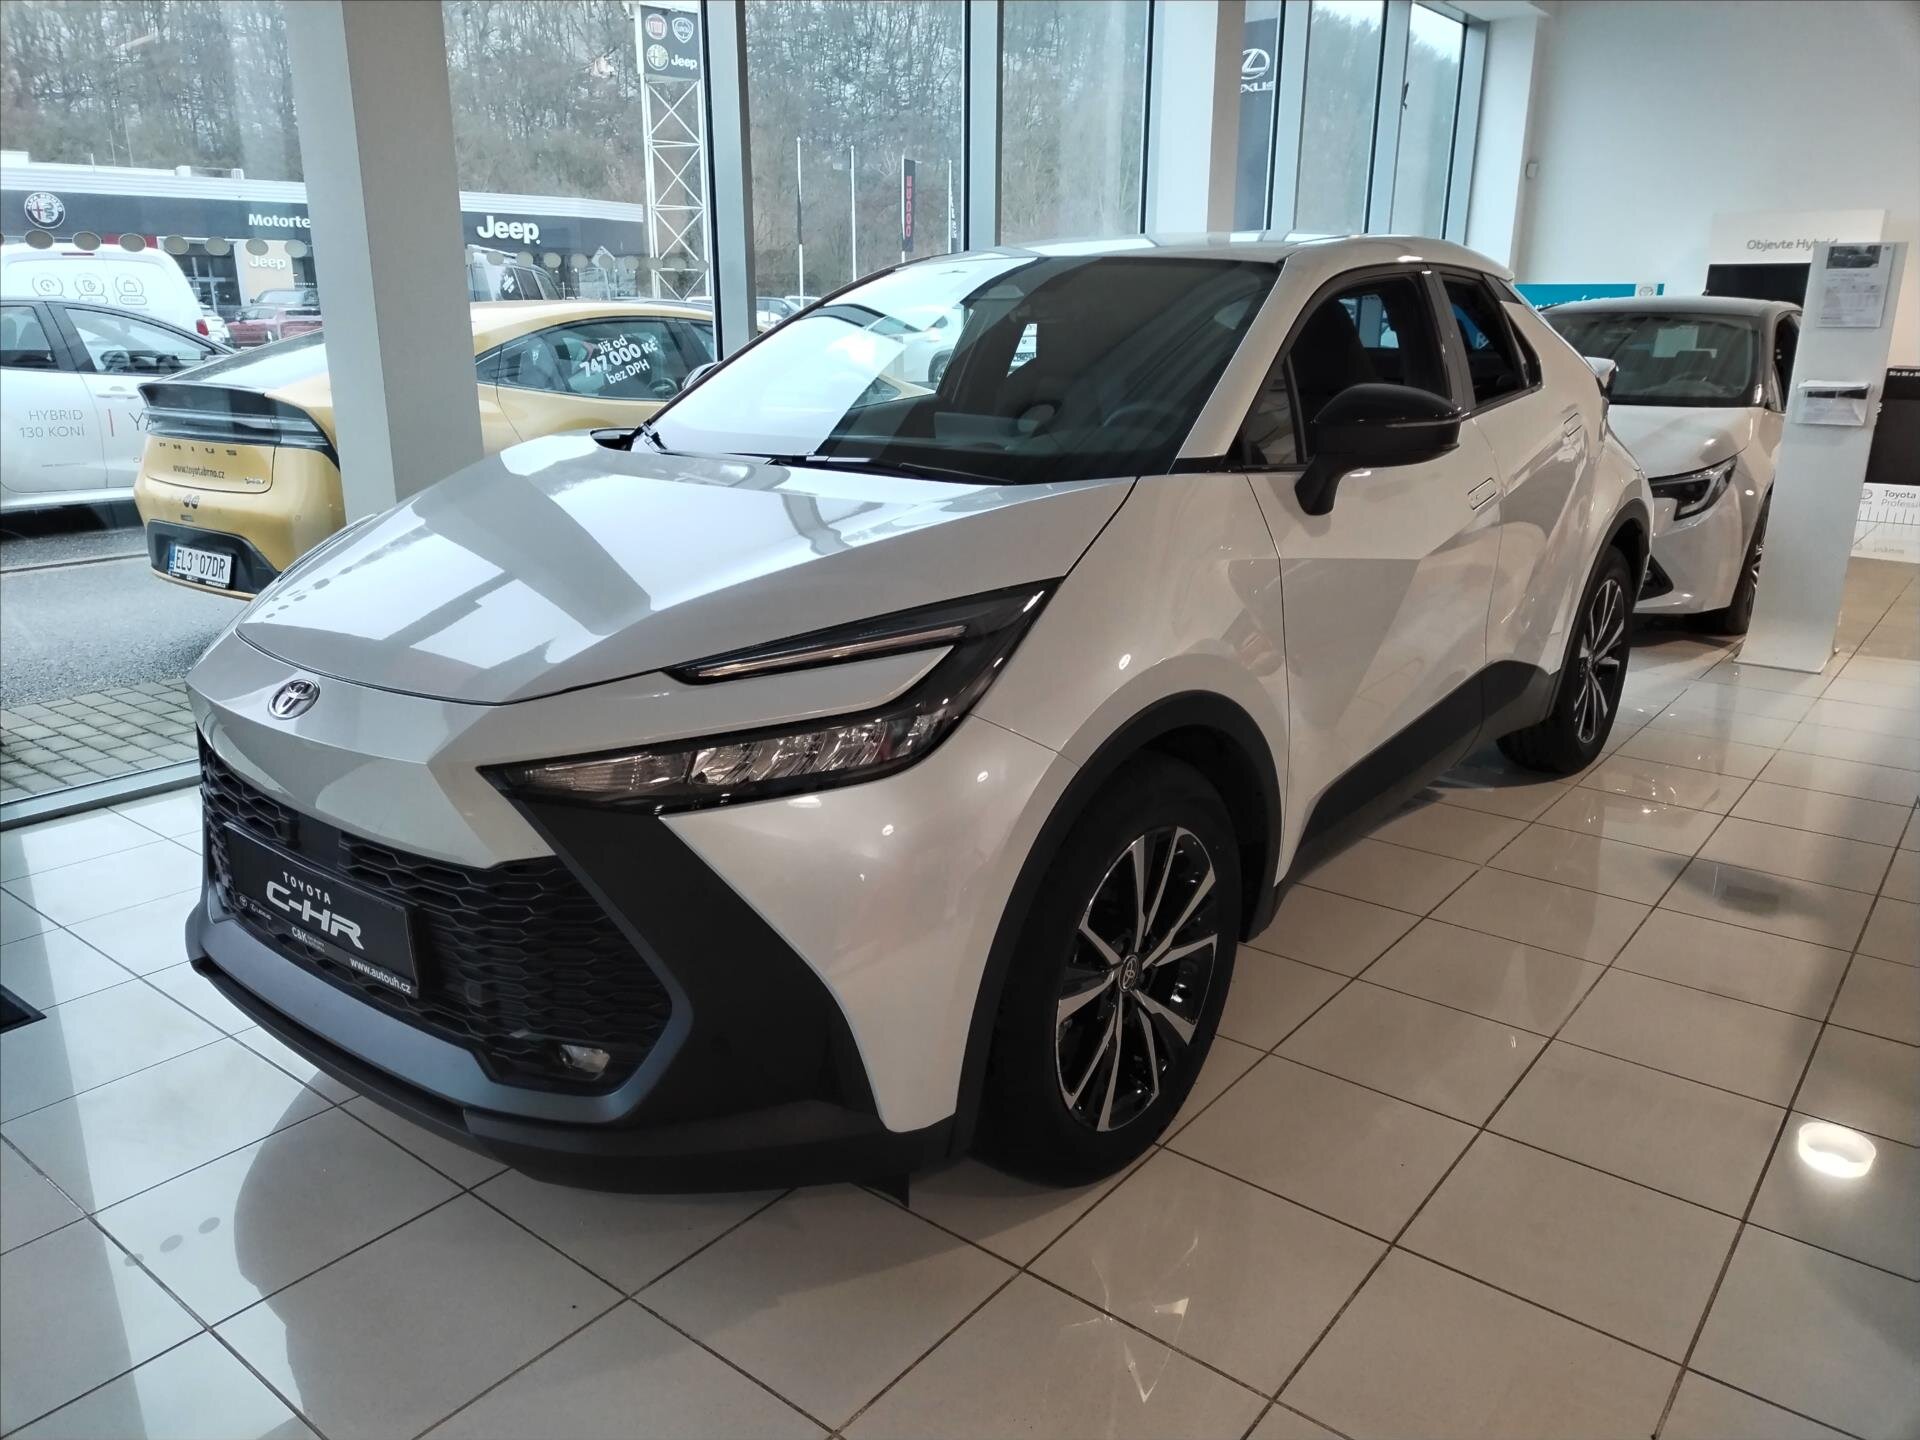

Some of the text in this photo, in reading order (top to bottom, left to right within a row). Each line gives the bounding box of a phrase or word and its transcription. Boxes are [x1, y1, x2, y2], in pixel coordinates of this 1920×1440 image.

[671, 54, 698, 70] Jeep
[477, 215, 540, 244] Jeep
[1746, 239, 1793, 252] Objevte
[249, 255, 286, 270] Jeep
[598, 334, 628, 355] Již od
[579, 354, 608, 378] 747
[608, 343, 642, 366] 000
[605, 358, 651, 385] bez DPH
[28, 409, 84, 421] HYBRID
[19, 426, 44, 438] 130
[1884, 489, 1917, 499] Toyota
[175, 548, 226, 580] EL3 07DR
[282, 871, 331, 905] TOYOTA
[266, 880, 365, 950] C-HR
[350, 957, 412, 994] www.autouh.cz
